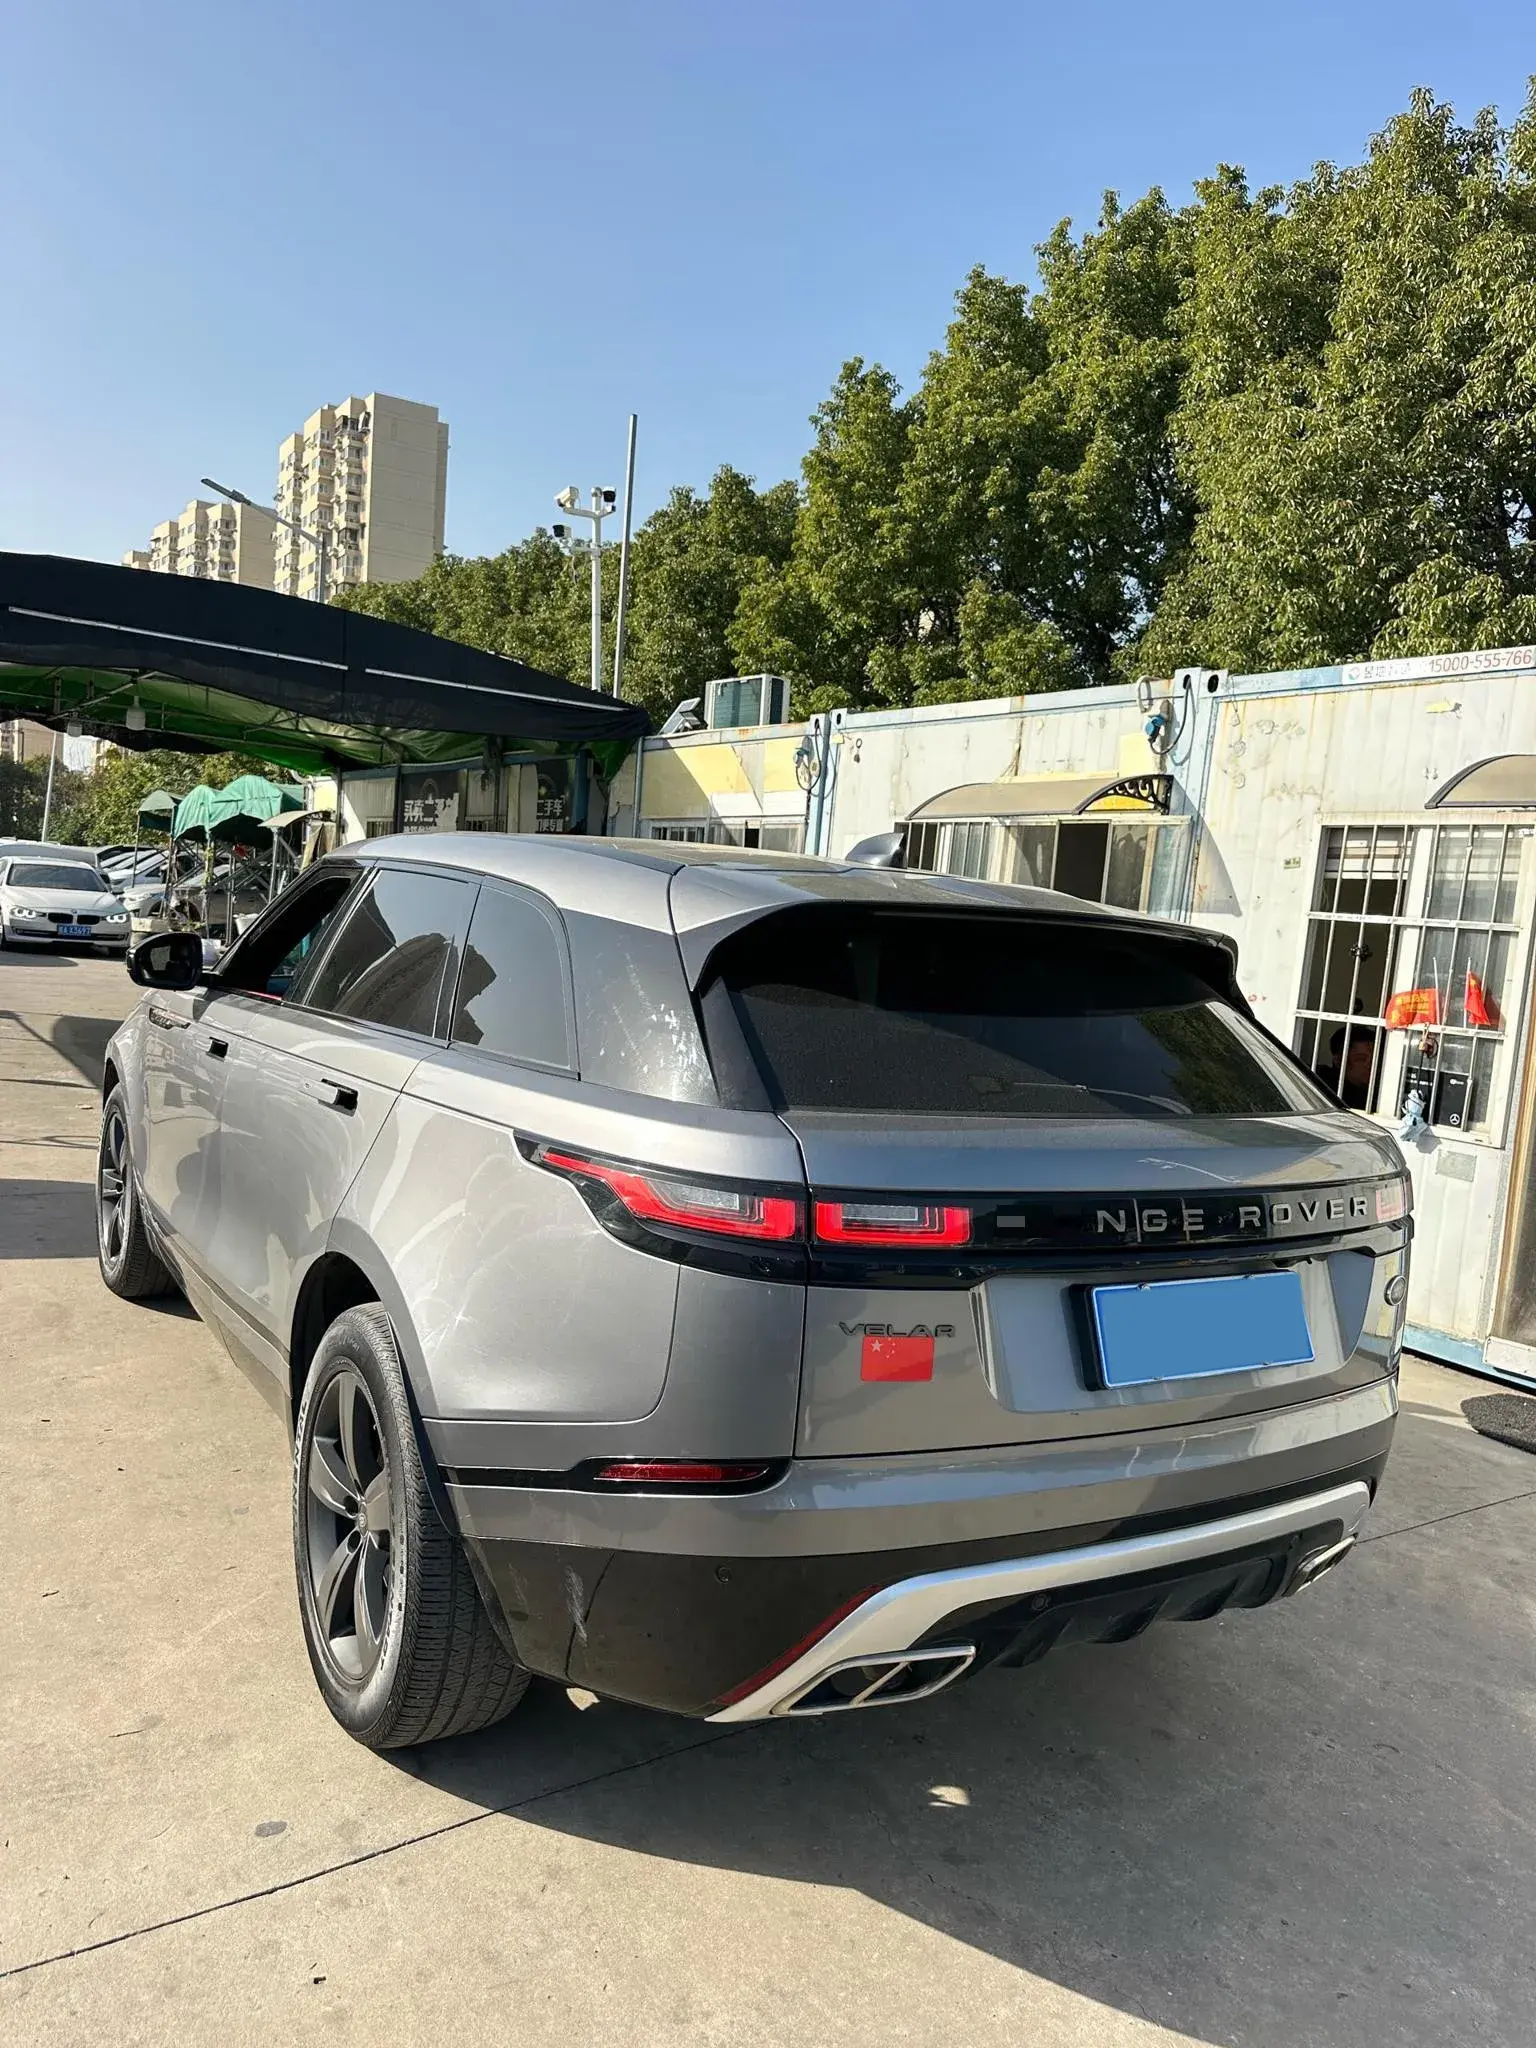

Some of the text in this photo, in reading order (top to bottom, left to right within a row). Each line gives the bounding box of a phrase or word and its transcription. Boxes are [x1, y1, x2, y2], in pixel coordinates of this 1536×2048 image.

[1429, 649, 1532, 673] 15000-555-766
[1239, 1196, 1368, 1229] ROVER
[838, 1321, 957, 1338] VELAR
